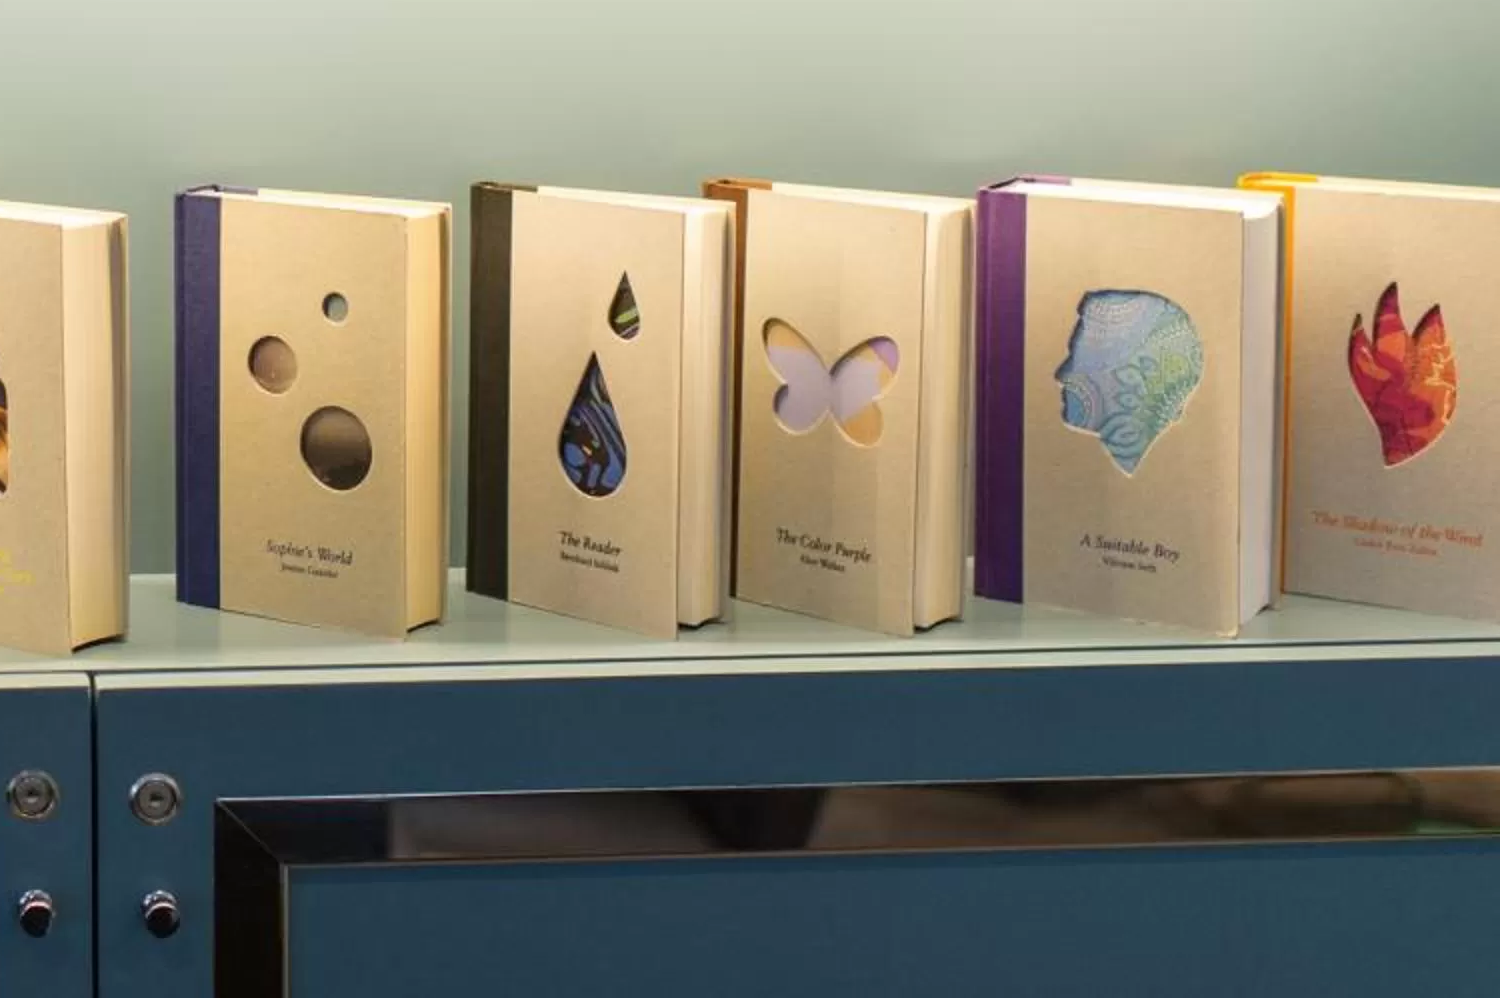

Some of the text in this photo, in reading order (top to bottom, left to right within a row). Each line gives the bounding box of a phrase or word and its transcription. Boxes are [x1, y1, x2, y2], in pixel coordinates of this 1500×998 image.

[557, 529, 622, 556] The Reader
[776, 526, 872, 564] The Color Purple
[1311, 509, 1340, 527] The
[1343, 514, 1398, 535] Shadow
[1443, 526, 1485, 548] Wind
[317, 545, 354, 566] World
[1079, 532, 1180, 565] A Suitable Boy
